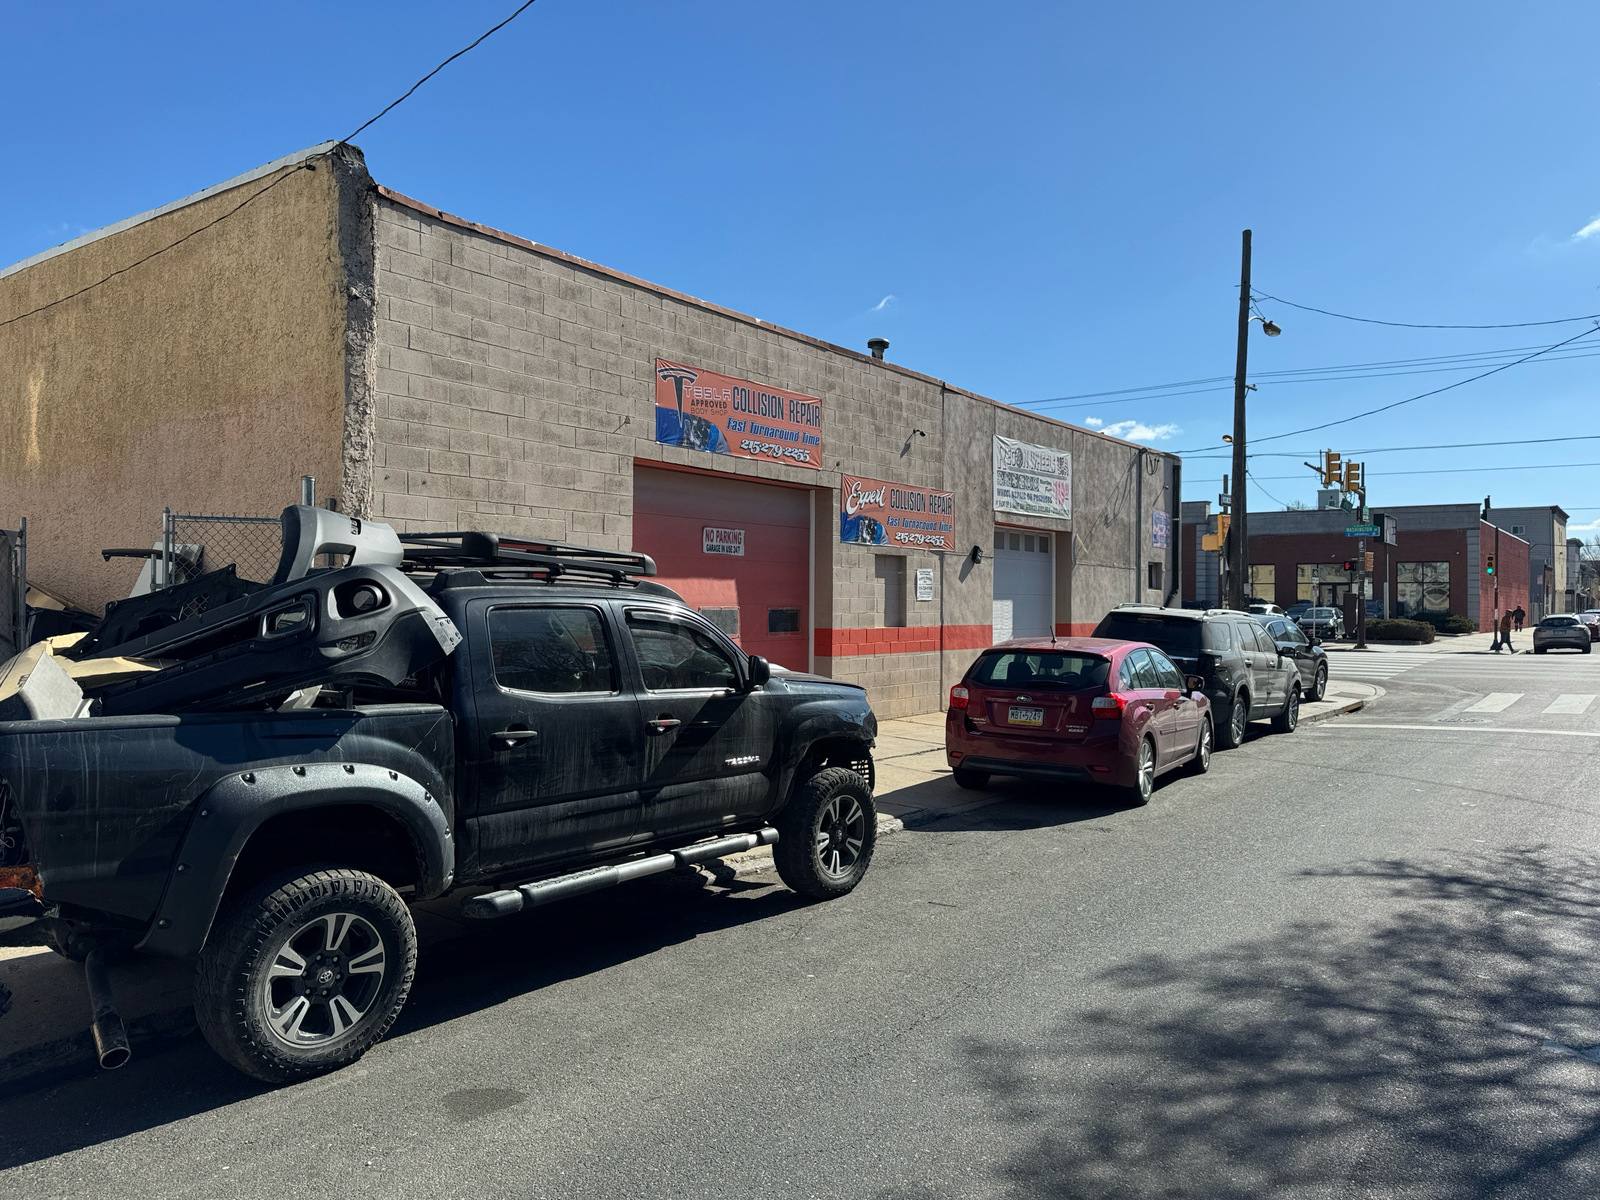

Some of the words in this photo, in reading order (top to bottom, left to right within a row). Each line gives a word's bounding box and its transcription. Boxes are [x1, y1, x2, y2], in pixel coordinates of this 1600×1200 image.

[684, 385, 732, 401] TESLA
[690, 399, 728, 409] APPROVED
[690, 407, 709, 415] BODY
[732, 385, 784, 420] COLLISION
[789, 399, 821, 428] REPAIR
[726, 417, 747, 433] Fast
[749, 421, 800, 442] Turnaround
[802, 430, 820, 446] Time
[845, 481, 886, 515] Expert
[890, 488, 926, 512] COLLISION
[929, 494, 953, 516] REPAIR
[886, 515, 900, 527] Fast
[901, 517, 937, 532] Turnaround
[938, 521, 953, 532] Time
[705, 529, 714, 542] NO
[716, 529, 742, 545] PARKING
[706, 544, 720, 552] GARAGE
